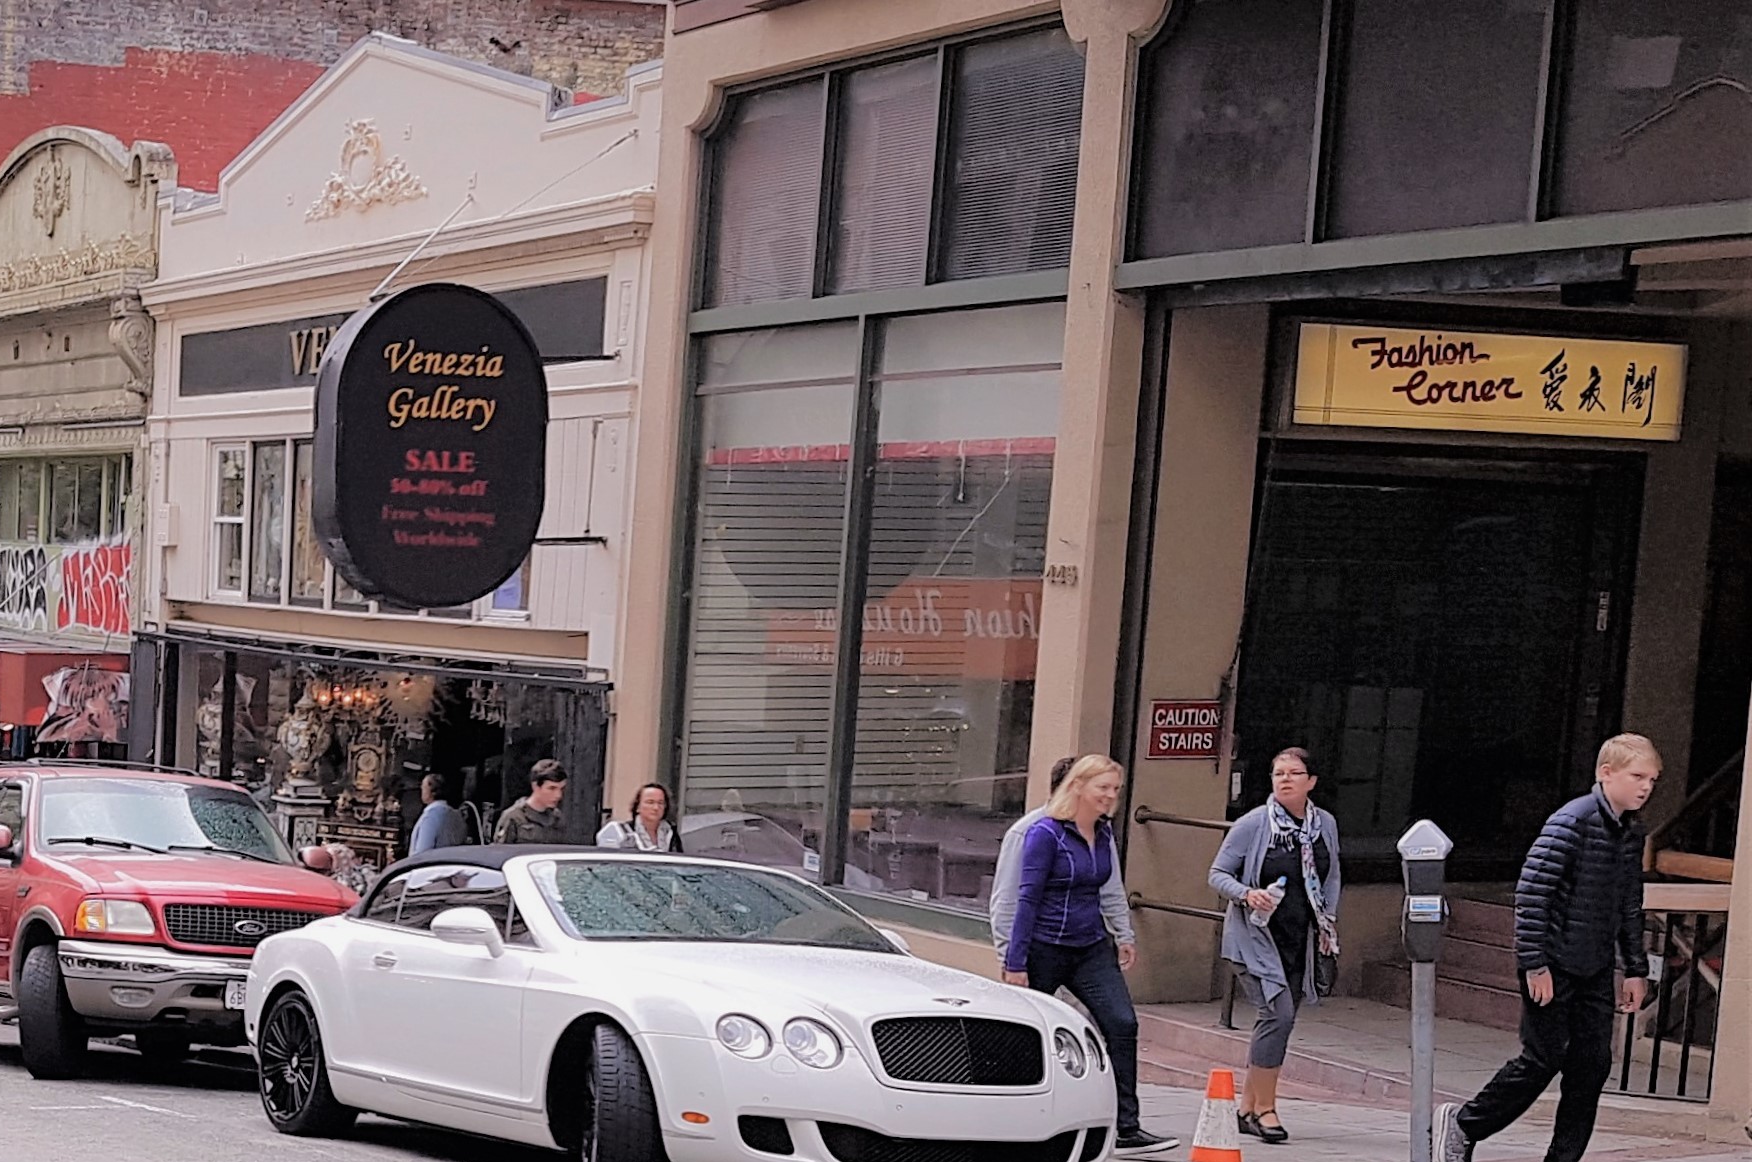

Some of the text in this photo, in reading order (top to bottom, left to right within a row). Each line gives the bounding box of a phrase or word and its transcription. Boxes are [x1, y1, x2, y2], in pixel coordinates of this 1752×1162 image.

[289, 326, 337, 376] VE
[383, 338, 505, 378] Venezia
[1351, 334, 1491, 370] Fashion
[1392, 370, 1523, 406] Corner
[387, 384, 497, 432] Gallery
[405, 448, 476, 473] SALE
[1155, 708, 1219, 726] CAUTION
[1158, 732, 1214, 751] STAIRS
